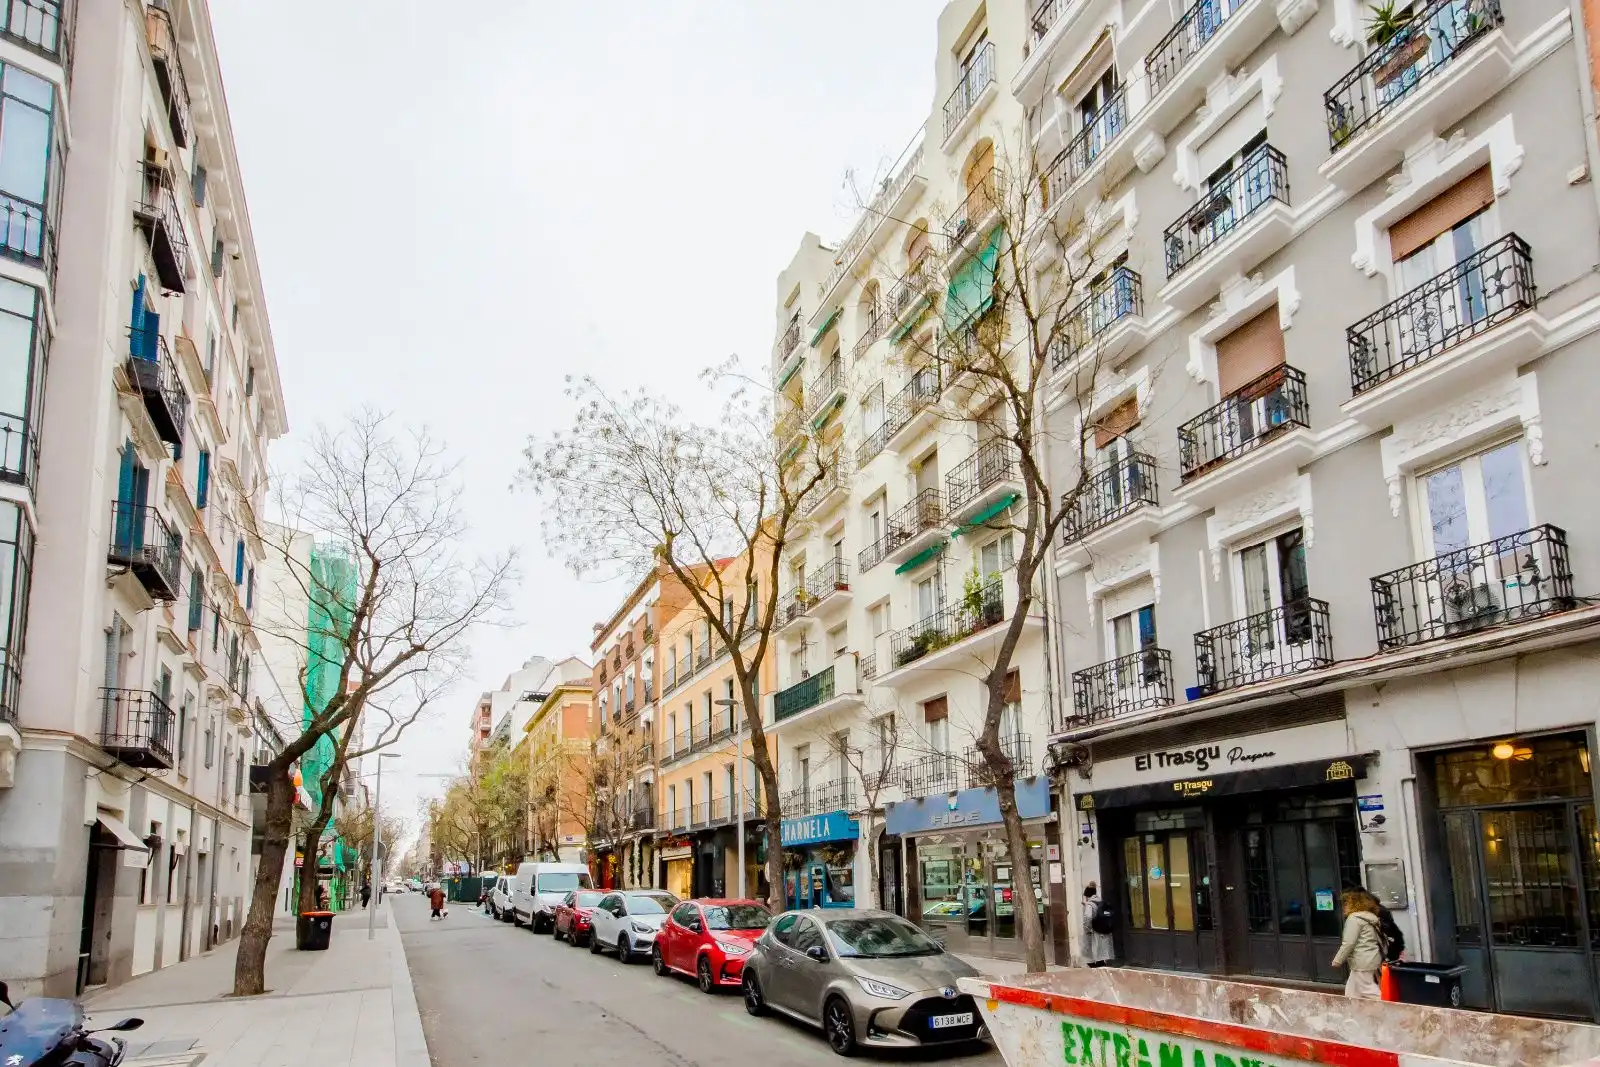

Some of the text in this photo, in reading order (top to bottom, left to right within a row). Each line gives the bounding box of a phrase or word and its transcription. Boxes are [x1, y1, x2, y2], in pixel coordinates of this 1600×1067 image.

[1135, 753, 1152, 771] El
[1154, 745, 1220, 771] Trasgu
[1173, 780, 1212, 792] El Trasgu
[934, 1016, 954, 1027] 6138
